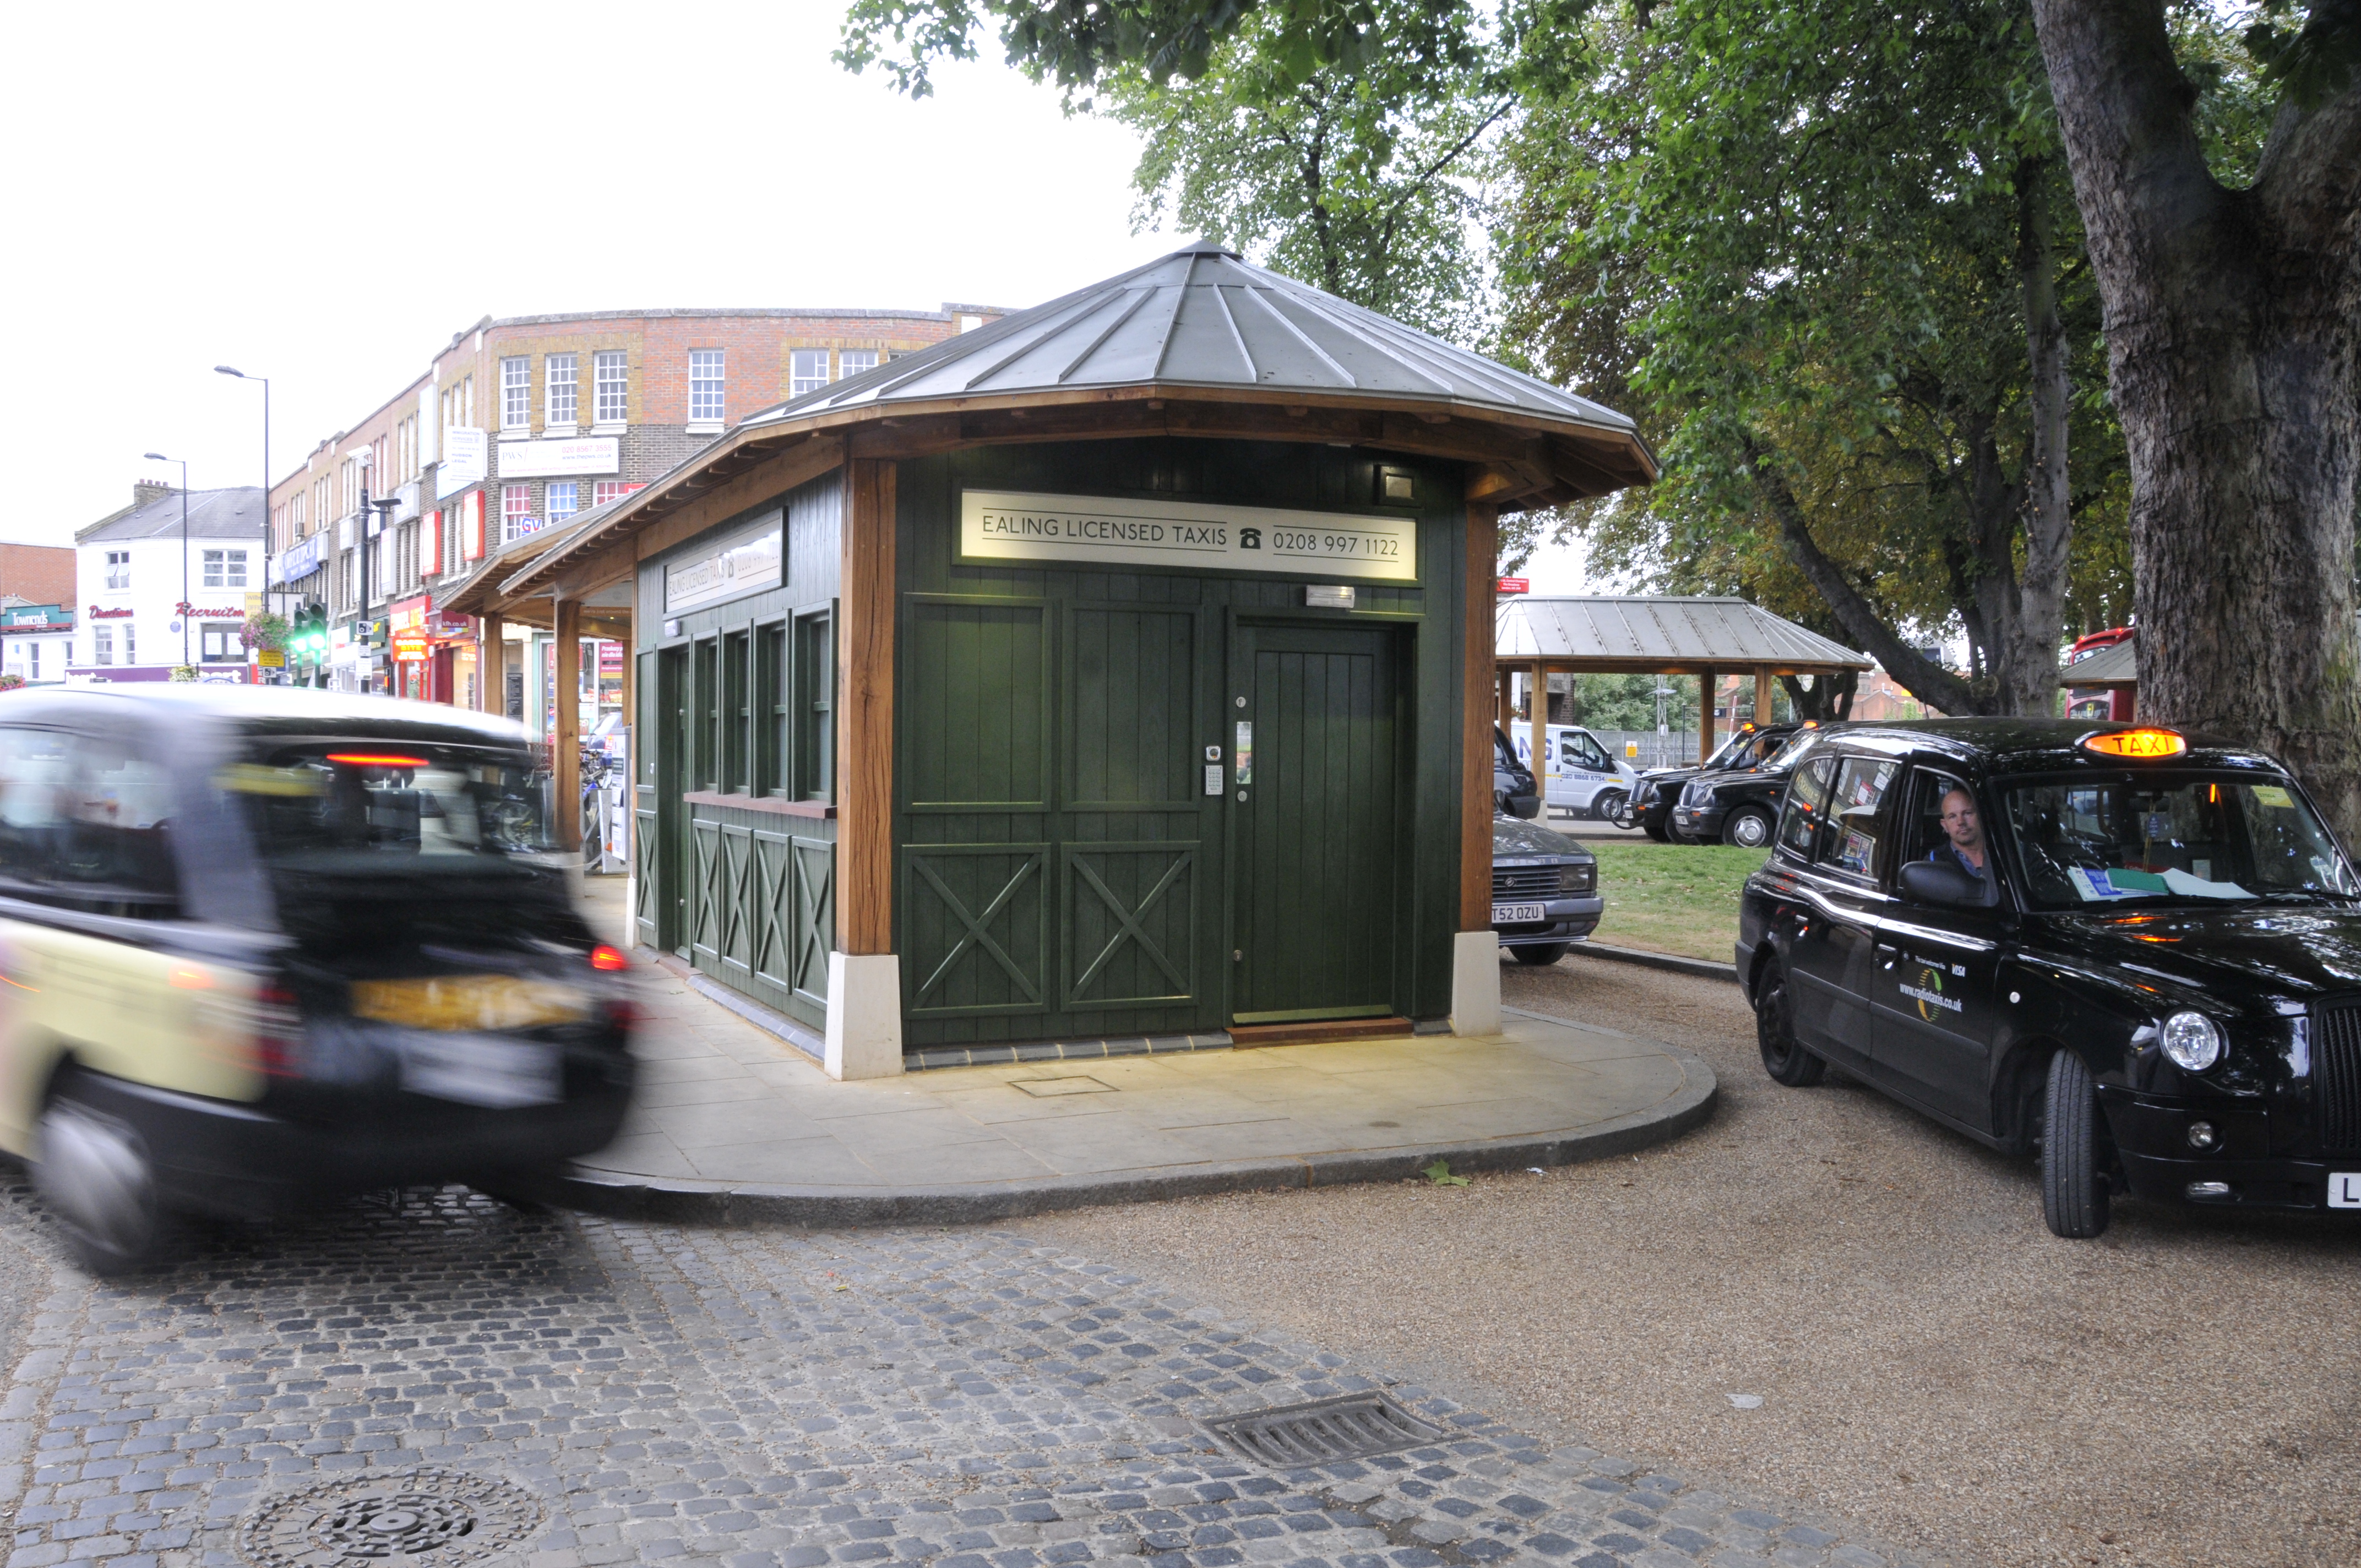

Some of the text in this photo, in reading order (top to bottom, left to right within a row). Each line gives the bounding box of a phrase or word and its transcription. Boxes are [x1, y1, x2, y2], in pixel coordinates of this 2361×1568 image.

[502, 451, 523, 460] PWS
[982, 515, 1227, 545] EALING LICENSED TAXIS
[1274, 532, 1399, 556] 0208 997 1122
[669, 560, 724, 596] EALING LICENSED TAXS
[12, 611, 48, 625] Townends
[2112, 736, 2170, 753] TAXI
[1517, 906, 1539, 919] OZU
[1952, 963, 1966, 977] VISA
[1900, 983, 1962, 1012] www.radiotaxis.co.uk
[2343, 1178, 2360, 1202] L
